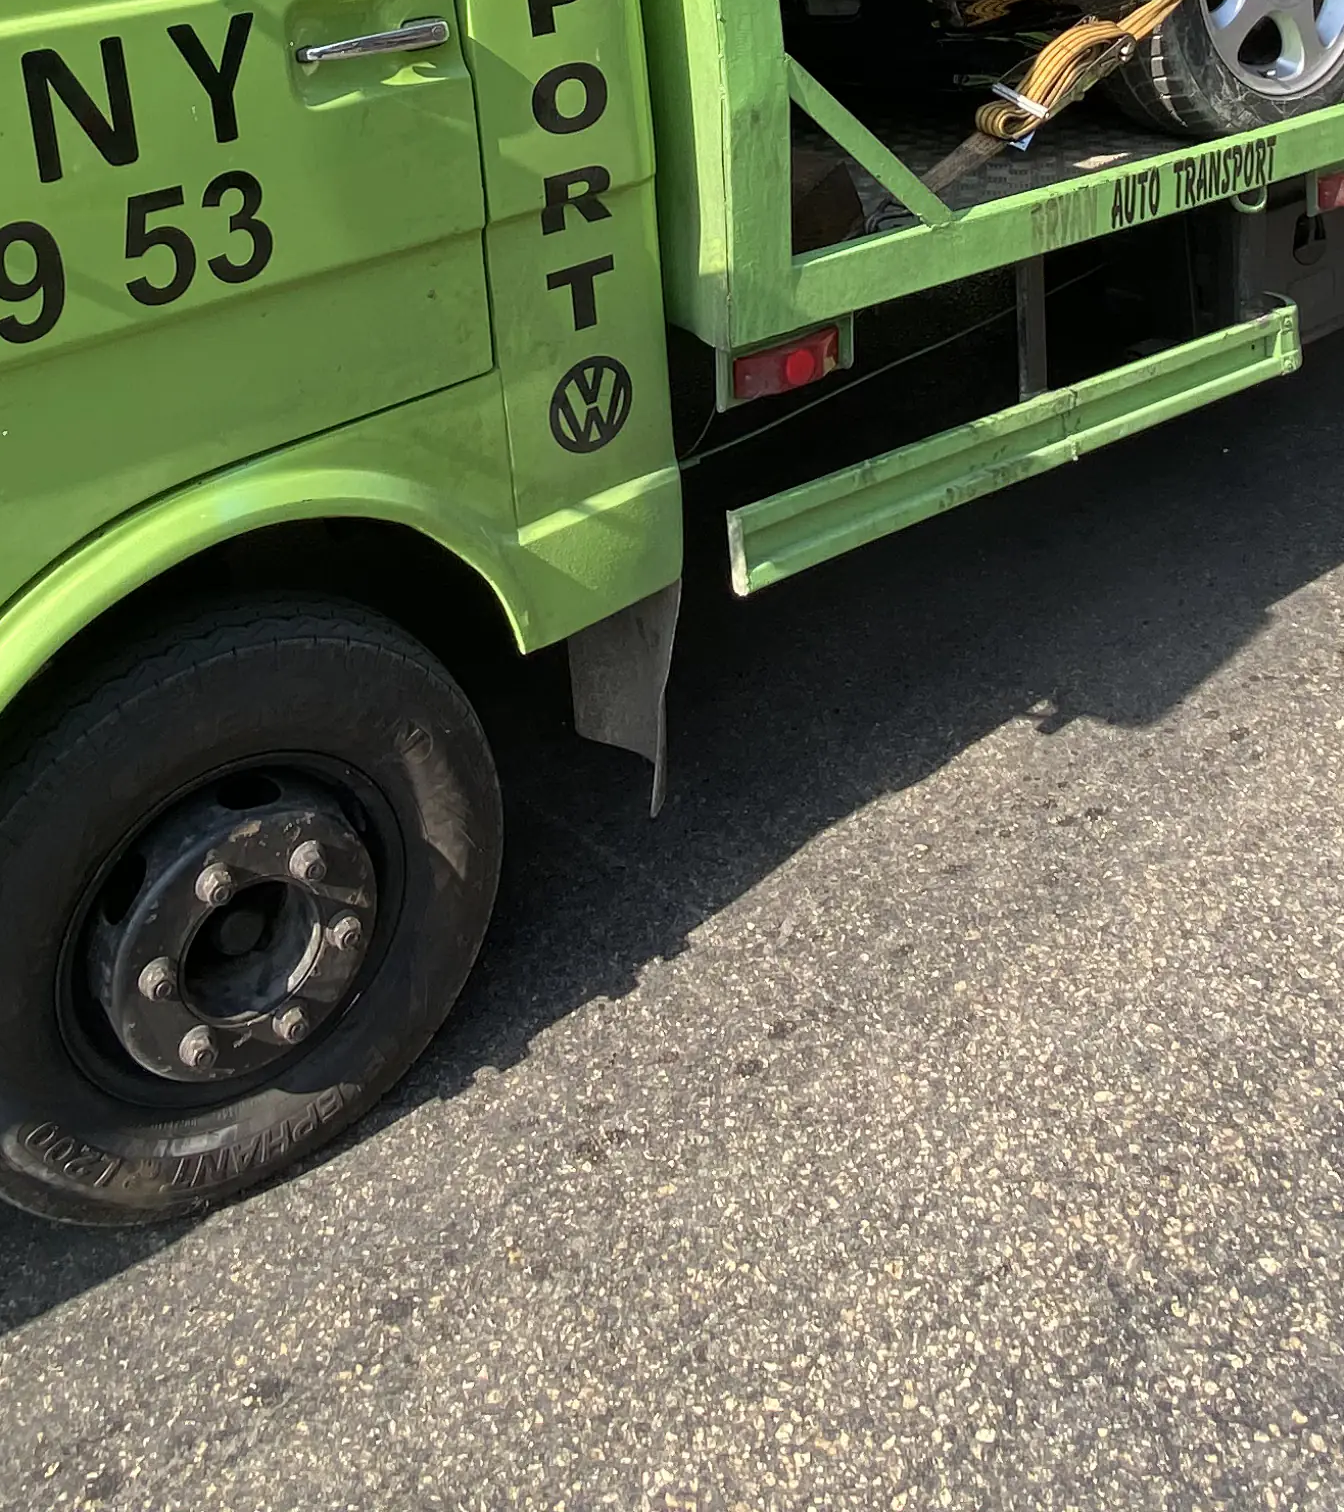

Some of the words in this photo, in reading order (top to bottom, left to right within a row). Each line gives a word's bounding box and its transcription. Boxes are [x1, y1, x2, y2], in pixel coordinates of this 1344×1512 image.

[124, 170, 274, 306] 53
[1112, 170, 1161, 229] AUTO
[1173, 135, 1277, 209] TRANSPORT
